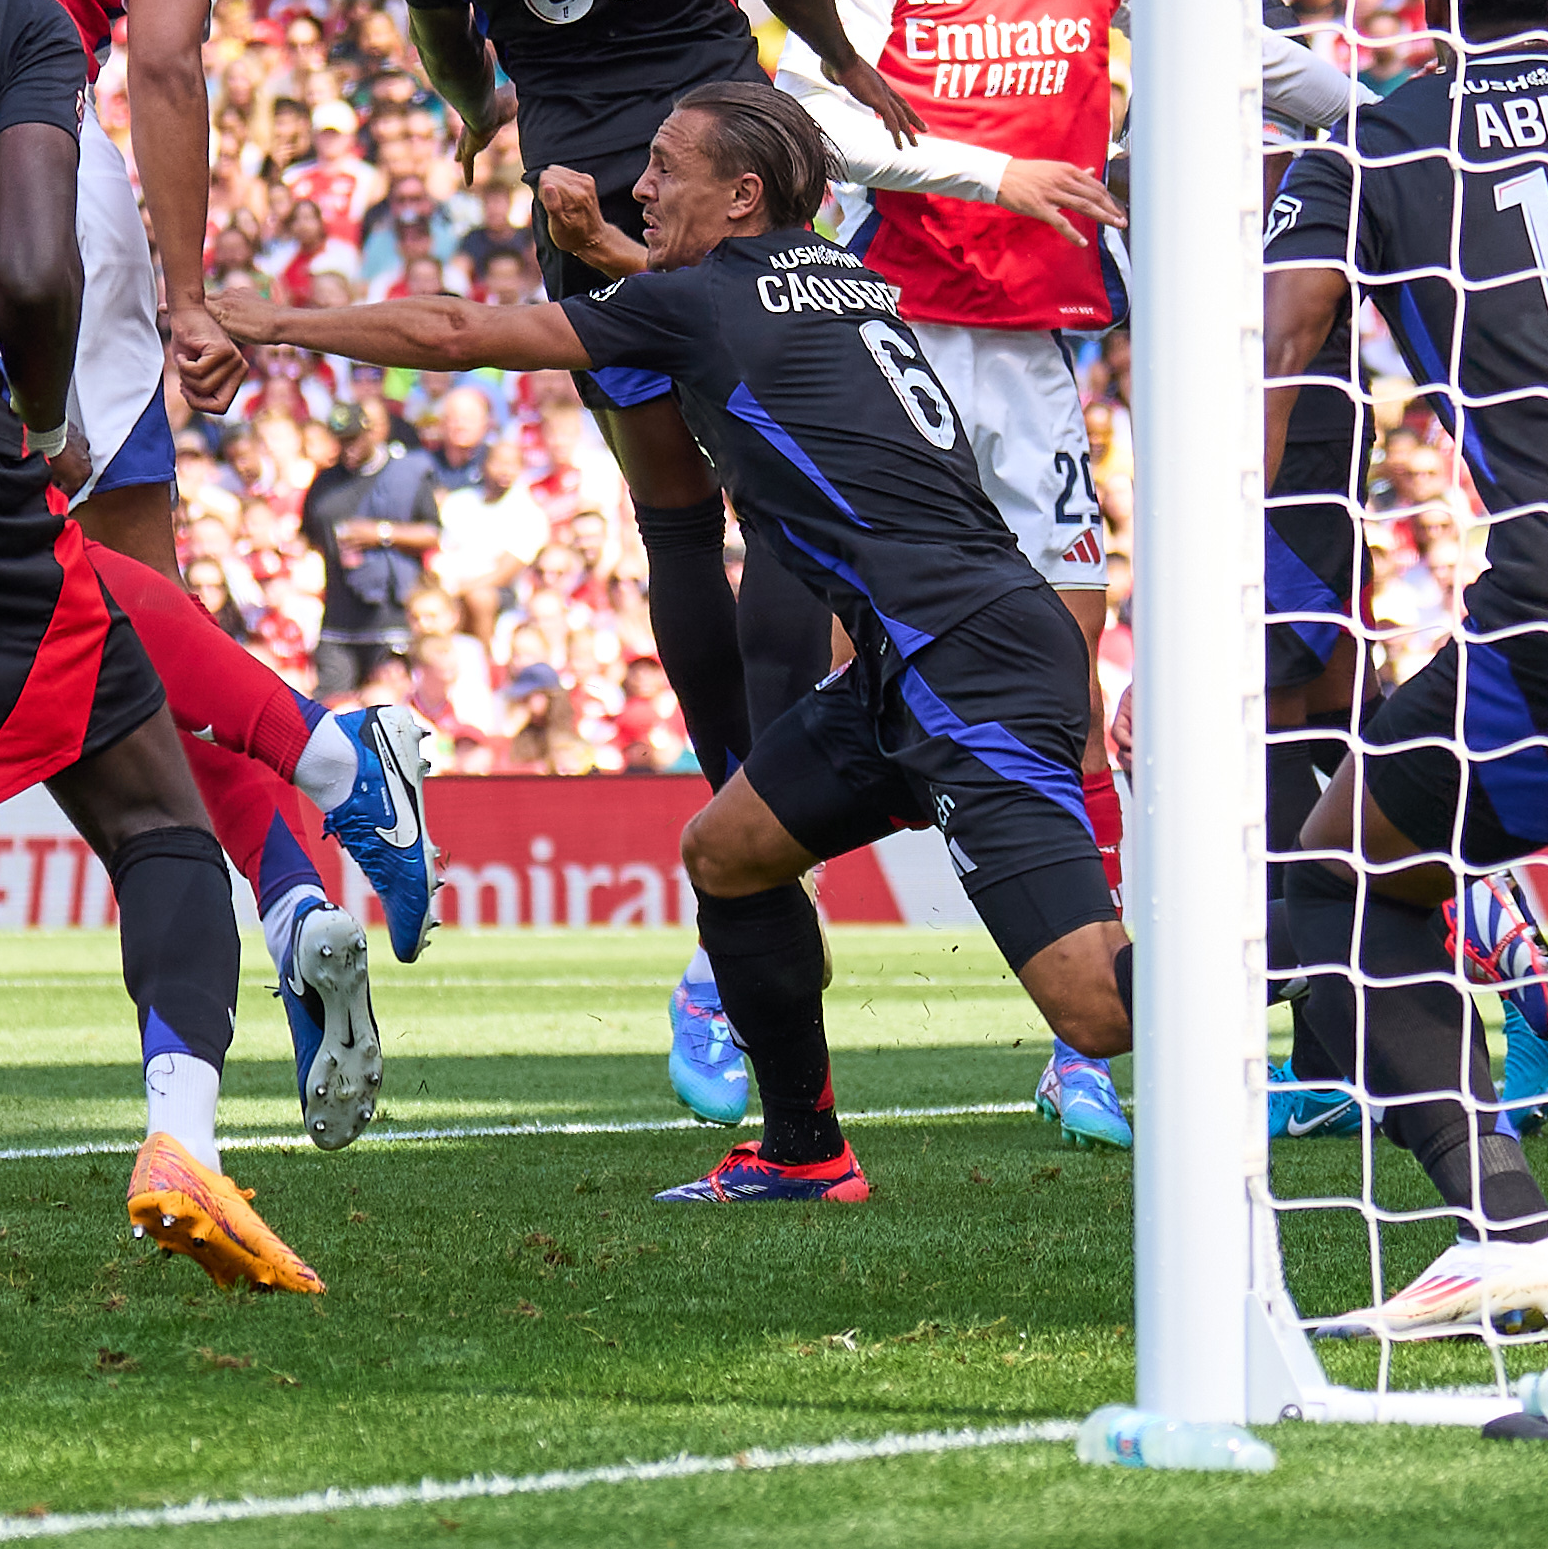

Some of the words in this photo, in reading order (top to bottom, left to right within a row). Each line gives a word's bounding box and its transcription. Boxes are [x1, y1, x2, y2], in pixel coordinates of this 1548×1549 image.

[905, 14, 1091, 61] Emirates
[933, 62, 981, 98] FLY
[984, 59, 1070, 98] BETTER
[858, 320, 957, 450] 6
